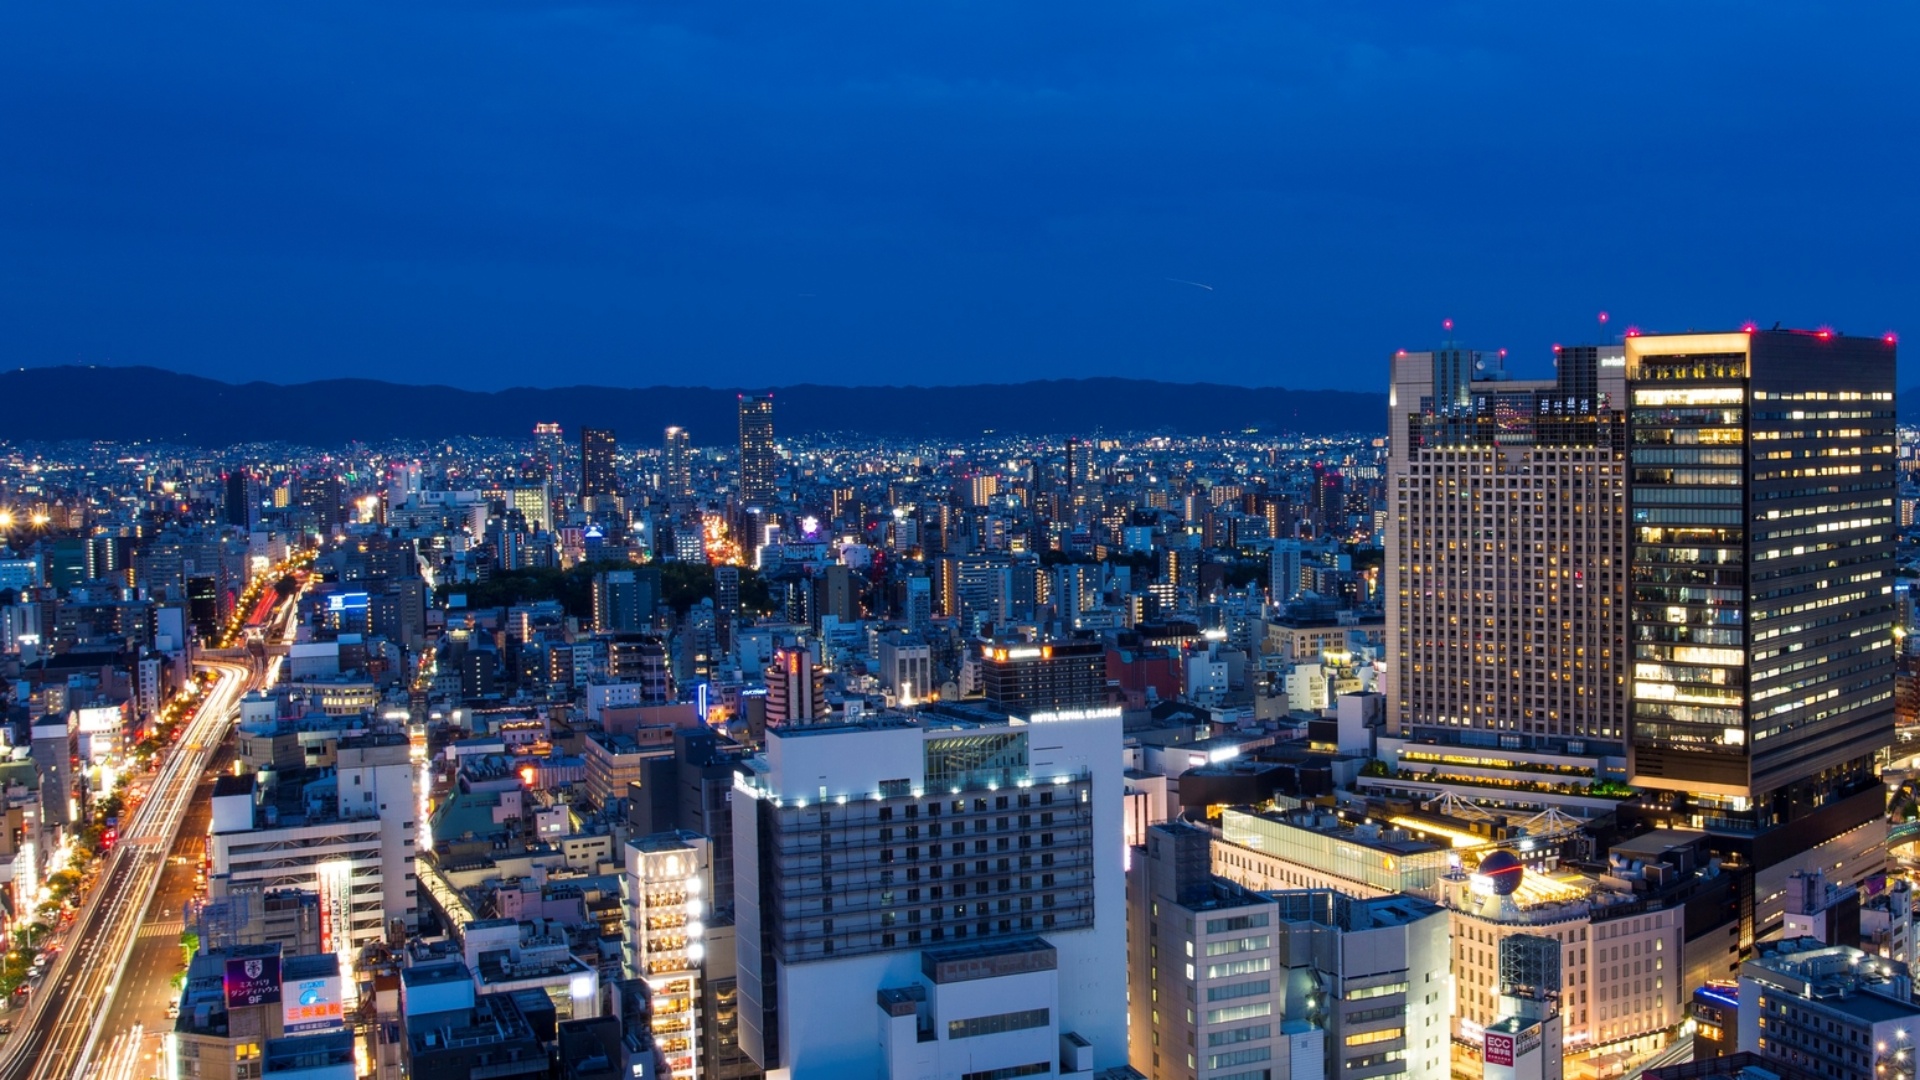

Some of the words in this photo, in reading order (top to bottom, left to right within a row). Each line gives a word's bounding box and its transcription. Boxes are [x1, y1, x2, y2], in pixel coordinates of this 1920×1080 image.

[850, 706, 859, 716] P
[1031, 713, 1058, 723] HOTEL
[1058, 710, 1085, 720] ROYAL
[1086, 707, 1121, 719] CLASSIC
[248, 994, 262, 1004] 9F
[1488, 1037, 1511, 1049] ECC
